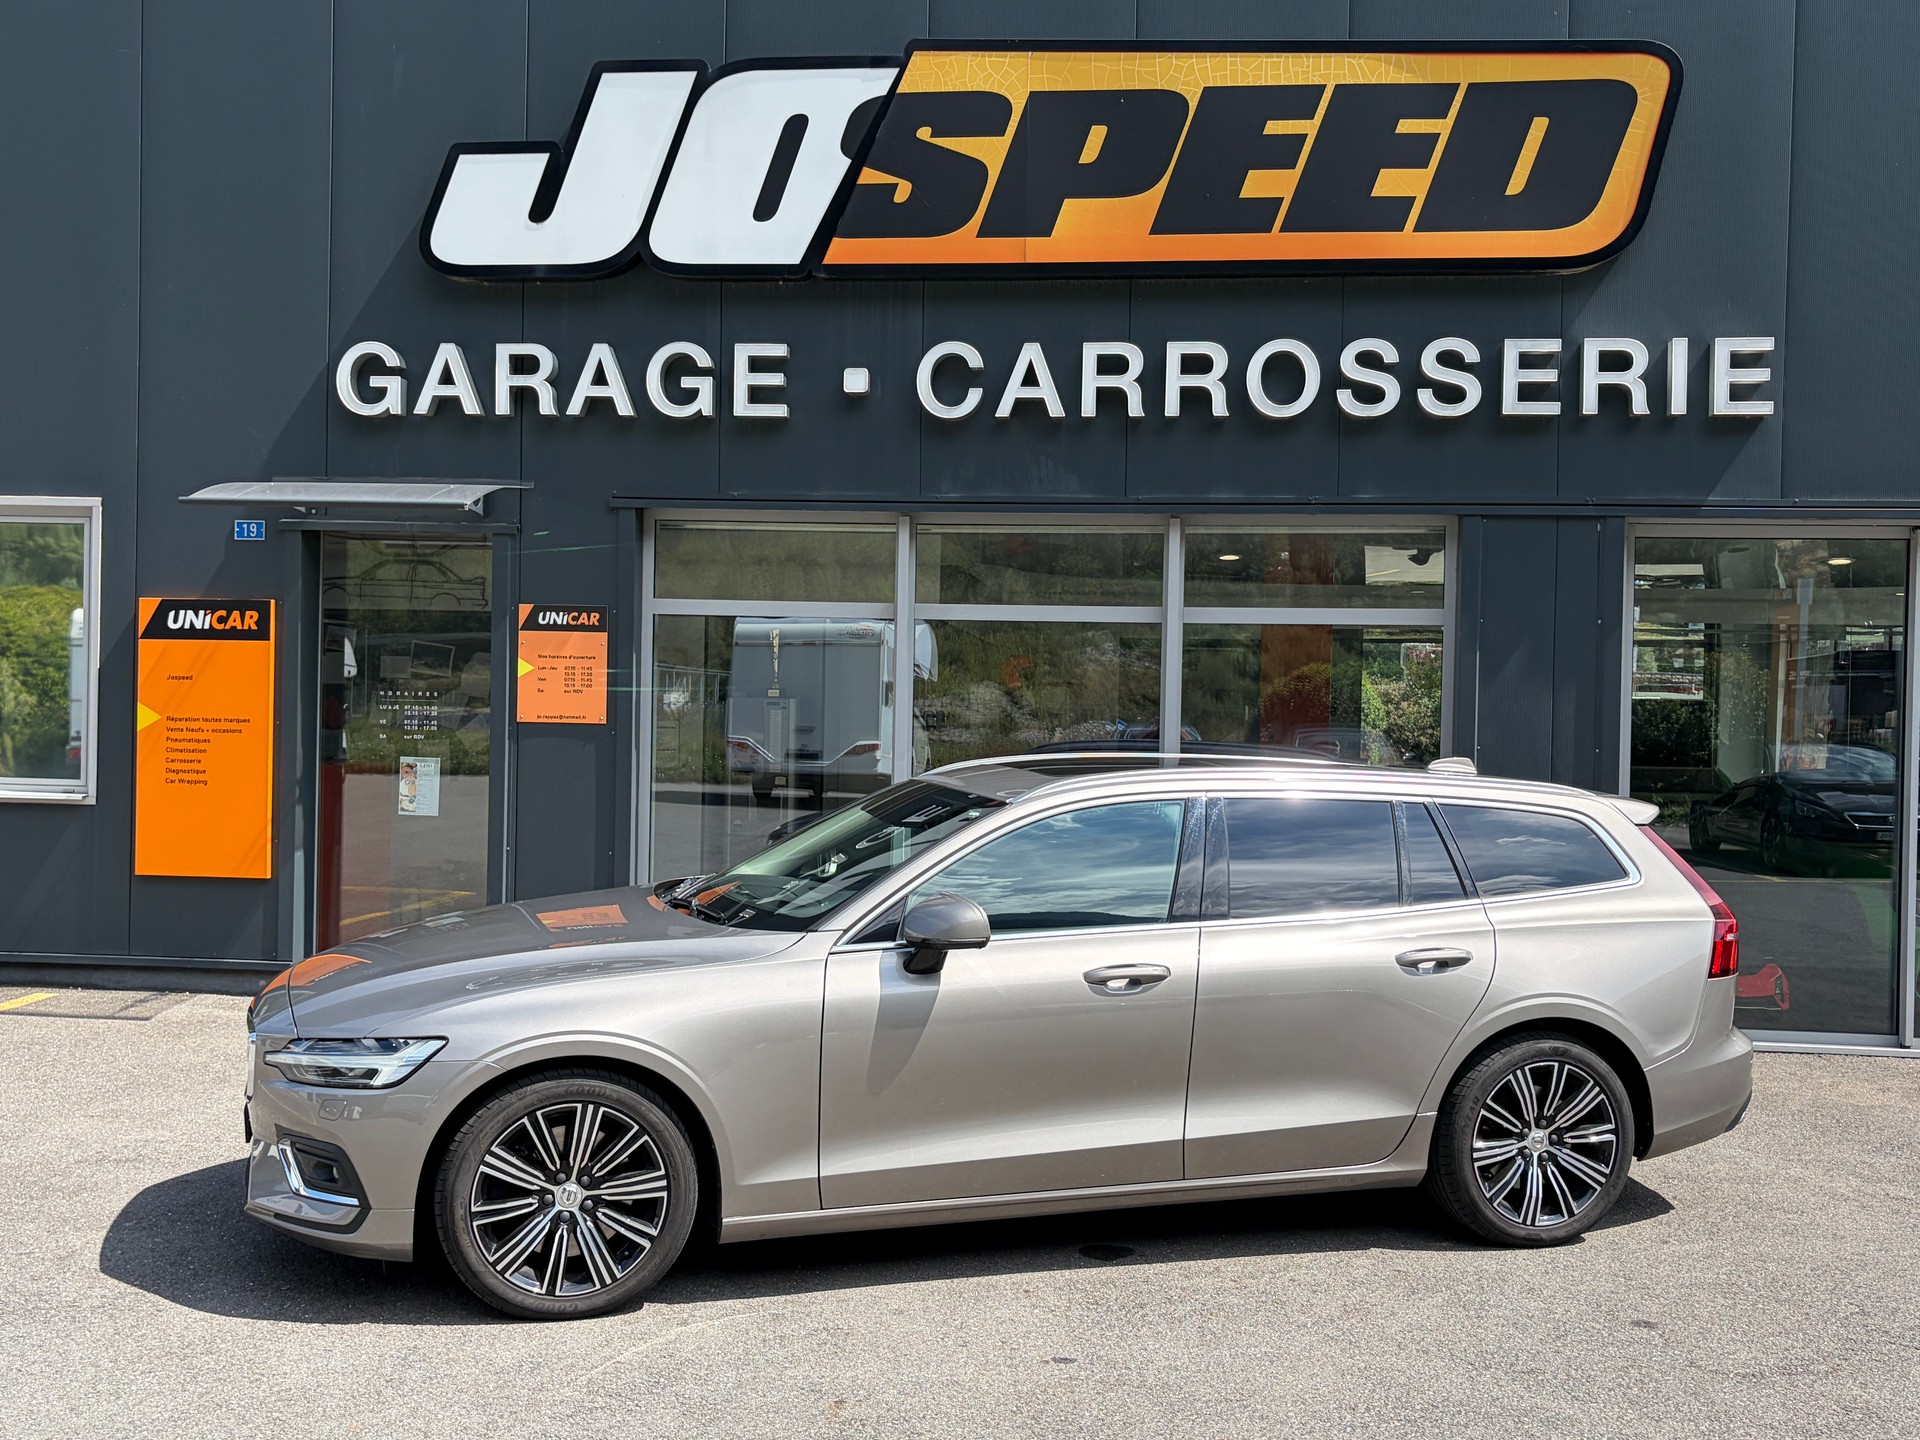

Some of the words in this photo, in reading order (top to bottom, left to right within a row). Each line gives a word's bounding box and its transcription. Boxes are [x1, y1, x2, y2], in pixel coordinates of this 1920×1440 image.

[335, 340, 790, 419] GARAGE
[916, 335, 1776, 420] CARROSSERIE
[242, 523, 257, 537] 19
[166, 674, 194, 682] Jospeed
[166, 715, 201, 723] Réparation
[166, 736, 211, 744] Pneumatiques
[165, 767, 207, 775] Diagnostique
[178, 778, 208, 786] Wrapping
